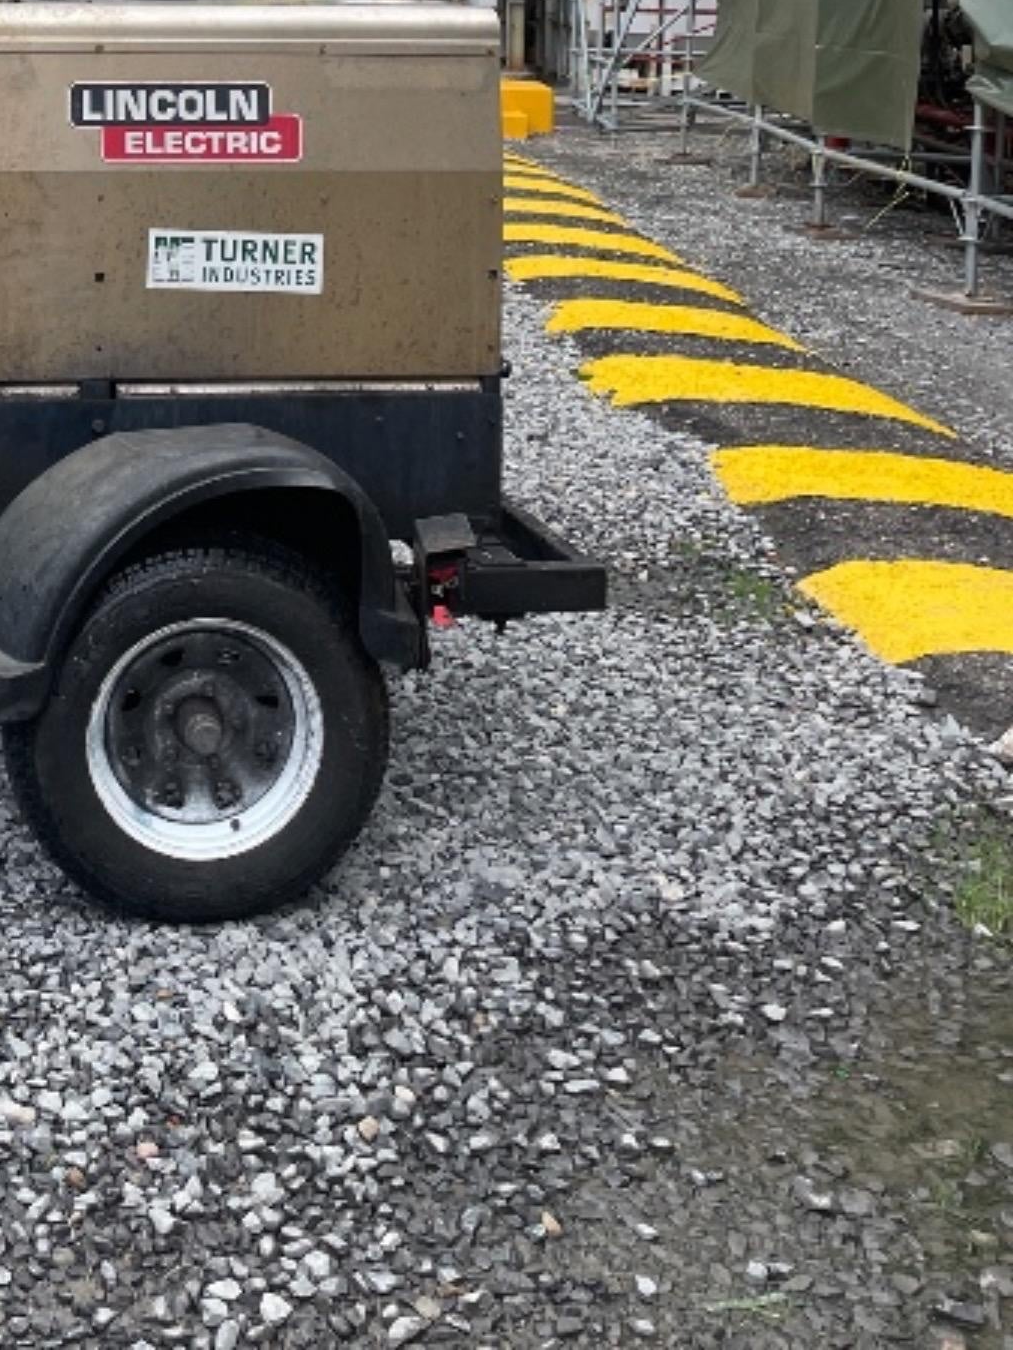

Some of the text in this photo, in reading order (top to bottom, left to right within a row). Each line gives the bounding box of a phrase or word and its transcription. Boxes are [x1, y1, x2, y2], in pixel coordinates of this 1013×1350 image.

[82, 89, 258, 121] LINCOLN
[124, 131, 282, 154] ELECTRIC
[201, 238, 317, 265] TURNER
[201, 266, 316, 287] INDUSTRIES
